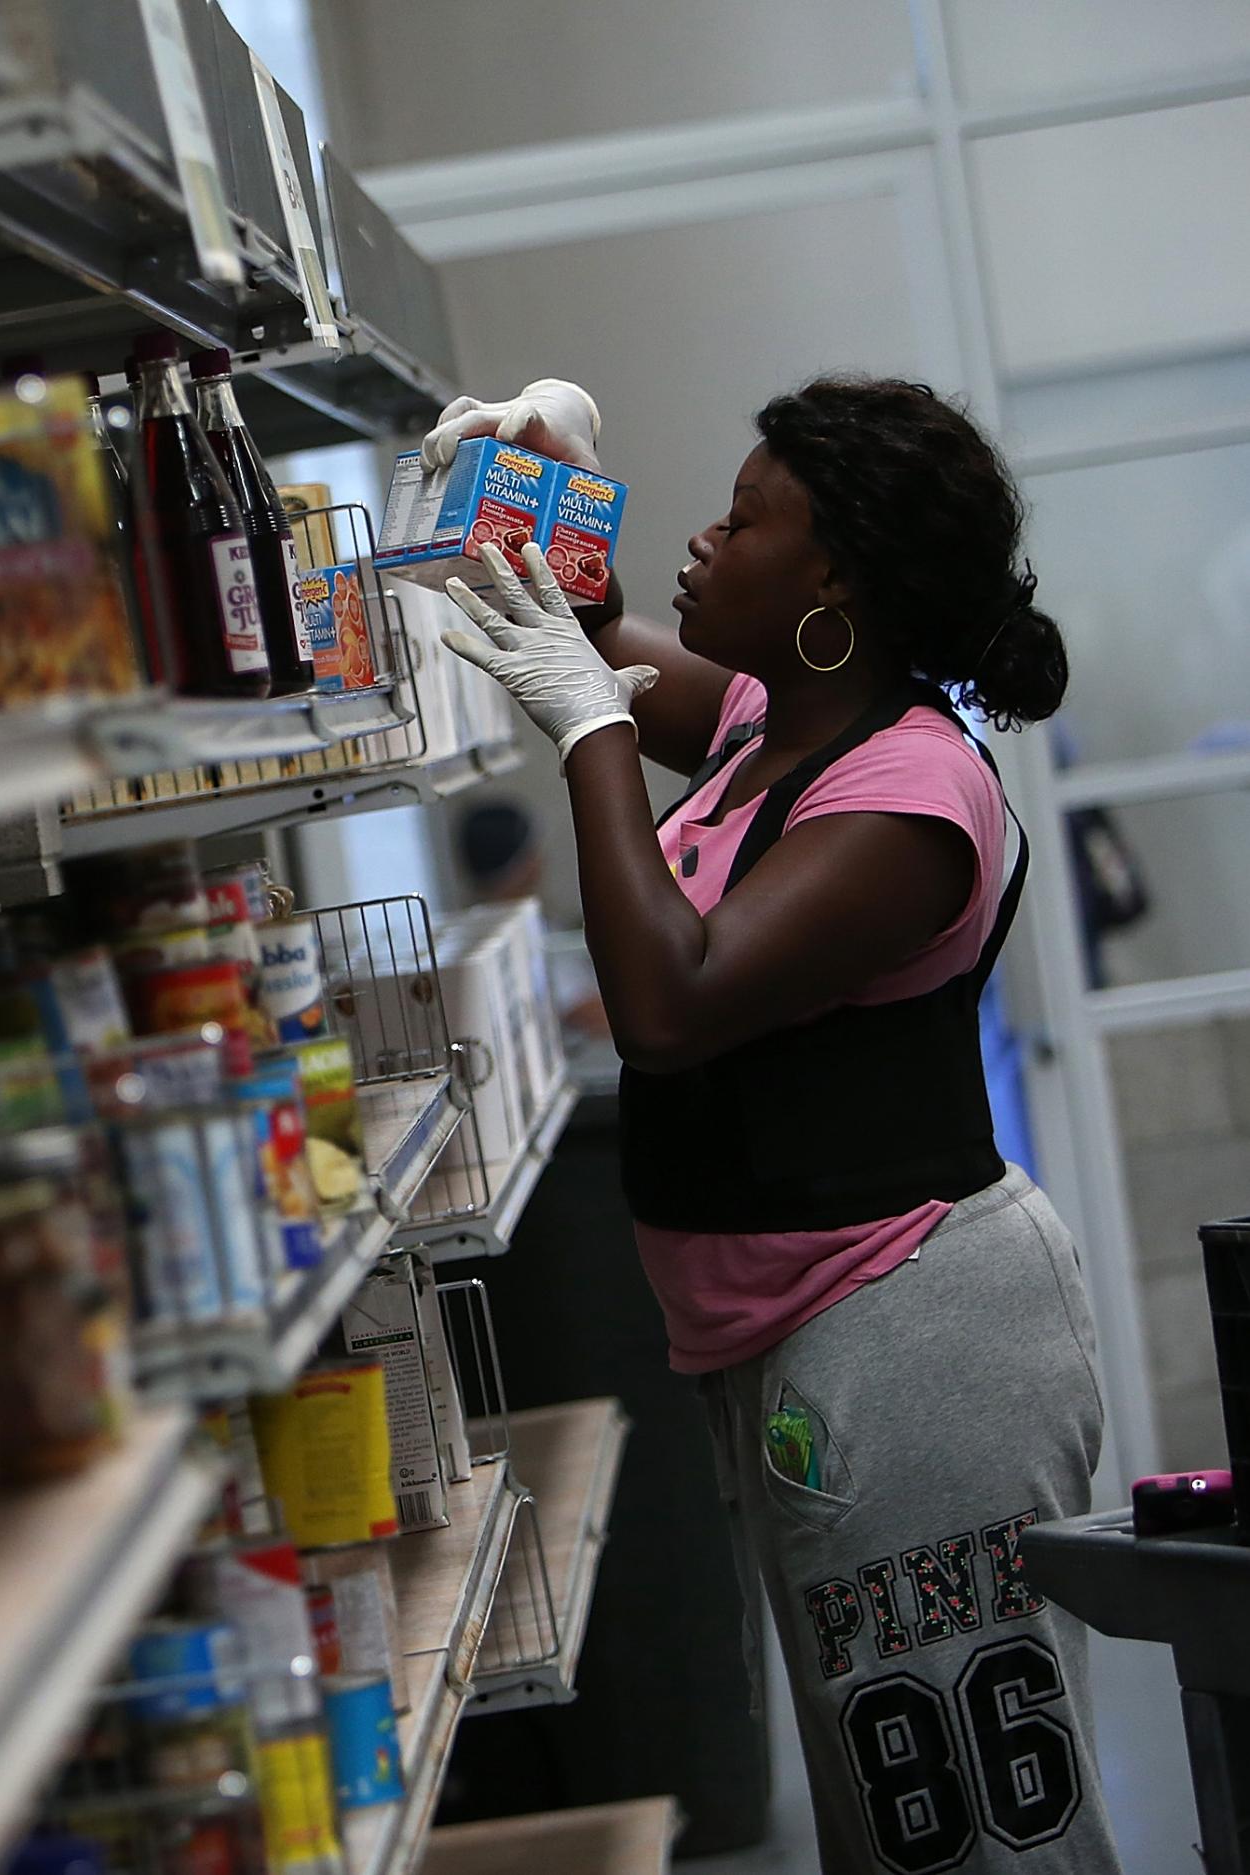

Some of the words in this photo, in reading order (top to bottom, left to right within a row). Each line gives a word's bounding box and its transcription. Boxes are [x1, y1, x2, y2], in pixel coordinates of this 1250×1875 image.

[497, 455, 540, 476] Emergen-C
[485, 468, 521, 489] MULTI
[484, 480, 539, 509] VITAMIN+
[570, 480, 613, 500] Emergen-C
[558, 494, 595, 514] MULTI
[481, 506, 525, 525] Pomegranate
[557, 506, 613, 534] VITAMIN+
[555, 531, 599, 550] Pomegranate
[227, 585, 255, 607] GR
[230, 606, 258, 632] JU
[306, 613, 322, 627] ULTI
[310, 627, 337, 641] TAMIN+
[803, 1508, 1048, 1680] PINK
[838, 1634, 1084, 1875] 86
